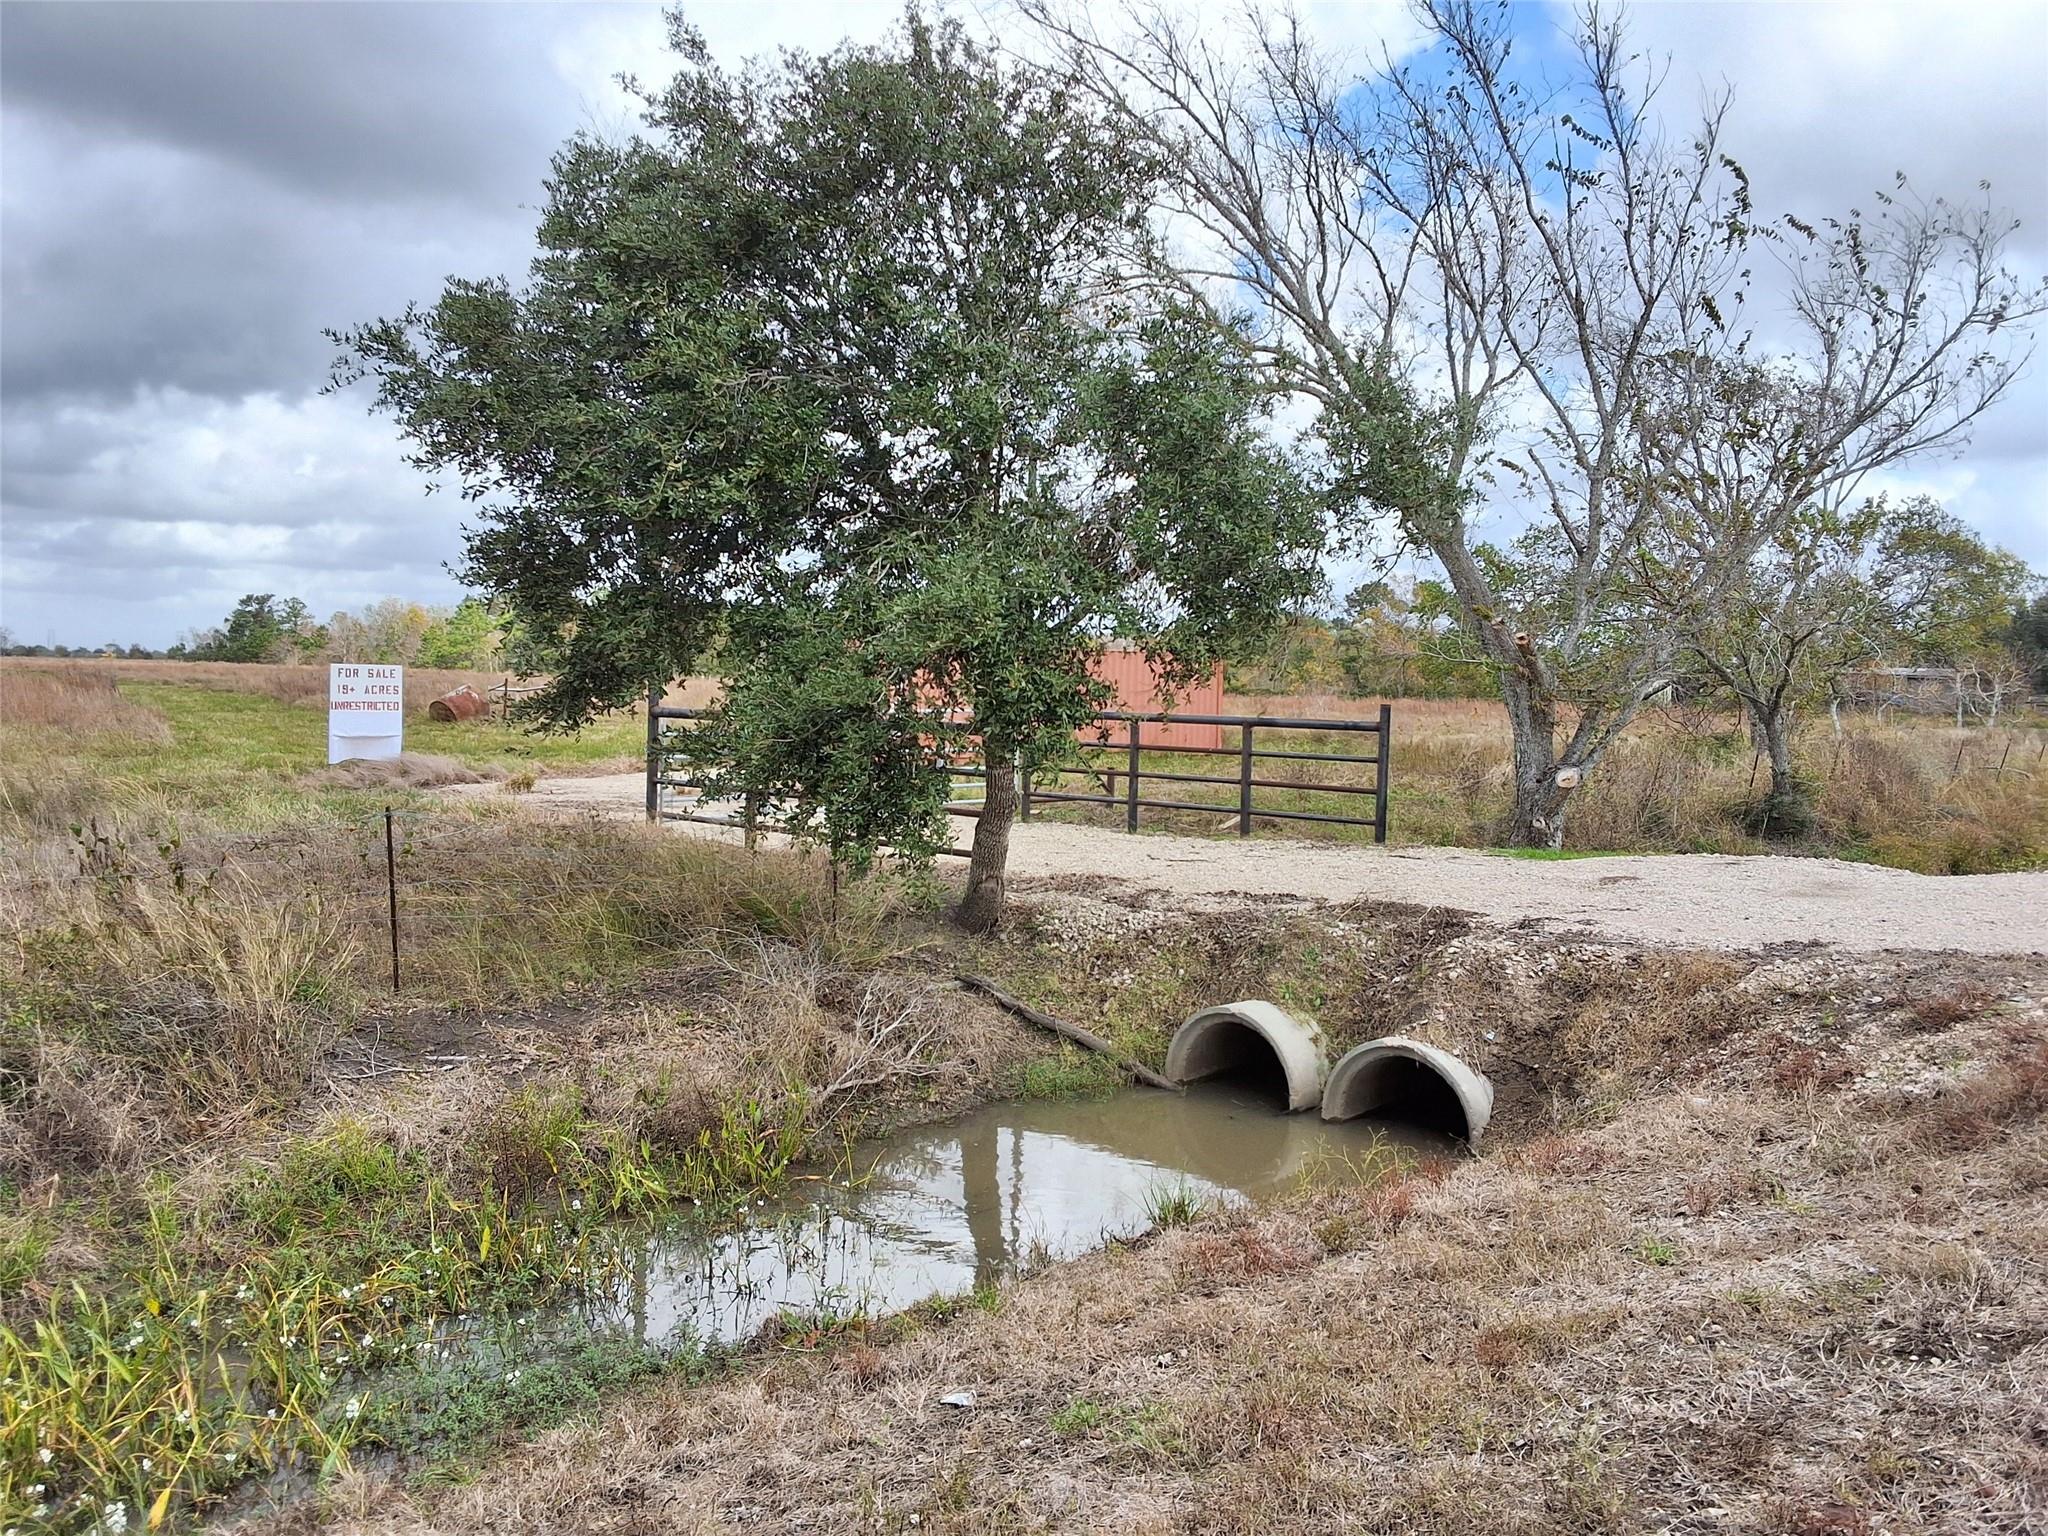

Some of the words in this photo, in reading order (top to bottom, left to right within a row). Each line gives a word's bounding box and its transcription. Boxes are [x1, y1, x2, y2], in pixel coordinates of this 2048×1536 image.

[338, 668, 359, 678] FOR
[367, 669, 396, 678] SALE
[338, 684, 356, 694] 19+
[364, 685, 399, 695] ACRES
[331, 701, 399, 711] UNRESTRICTED
